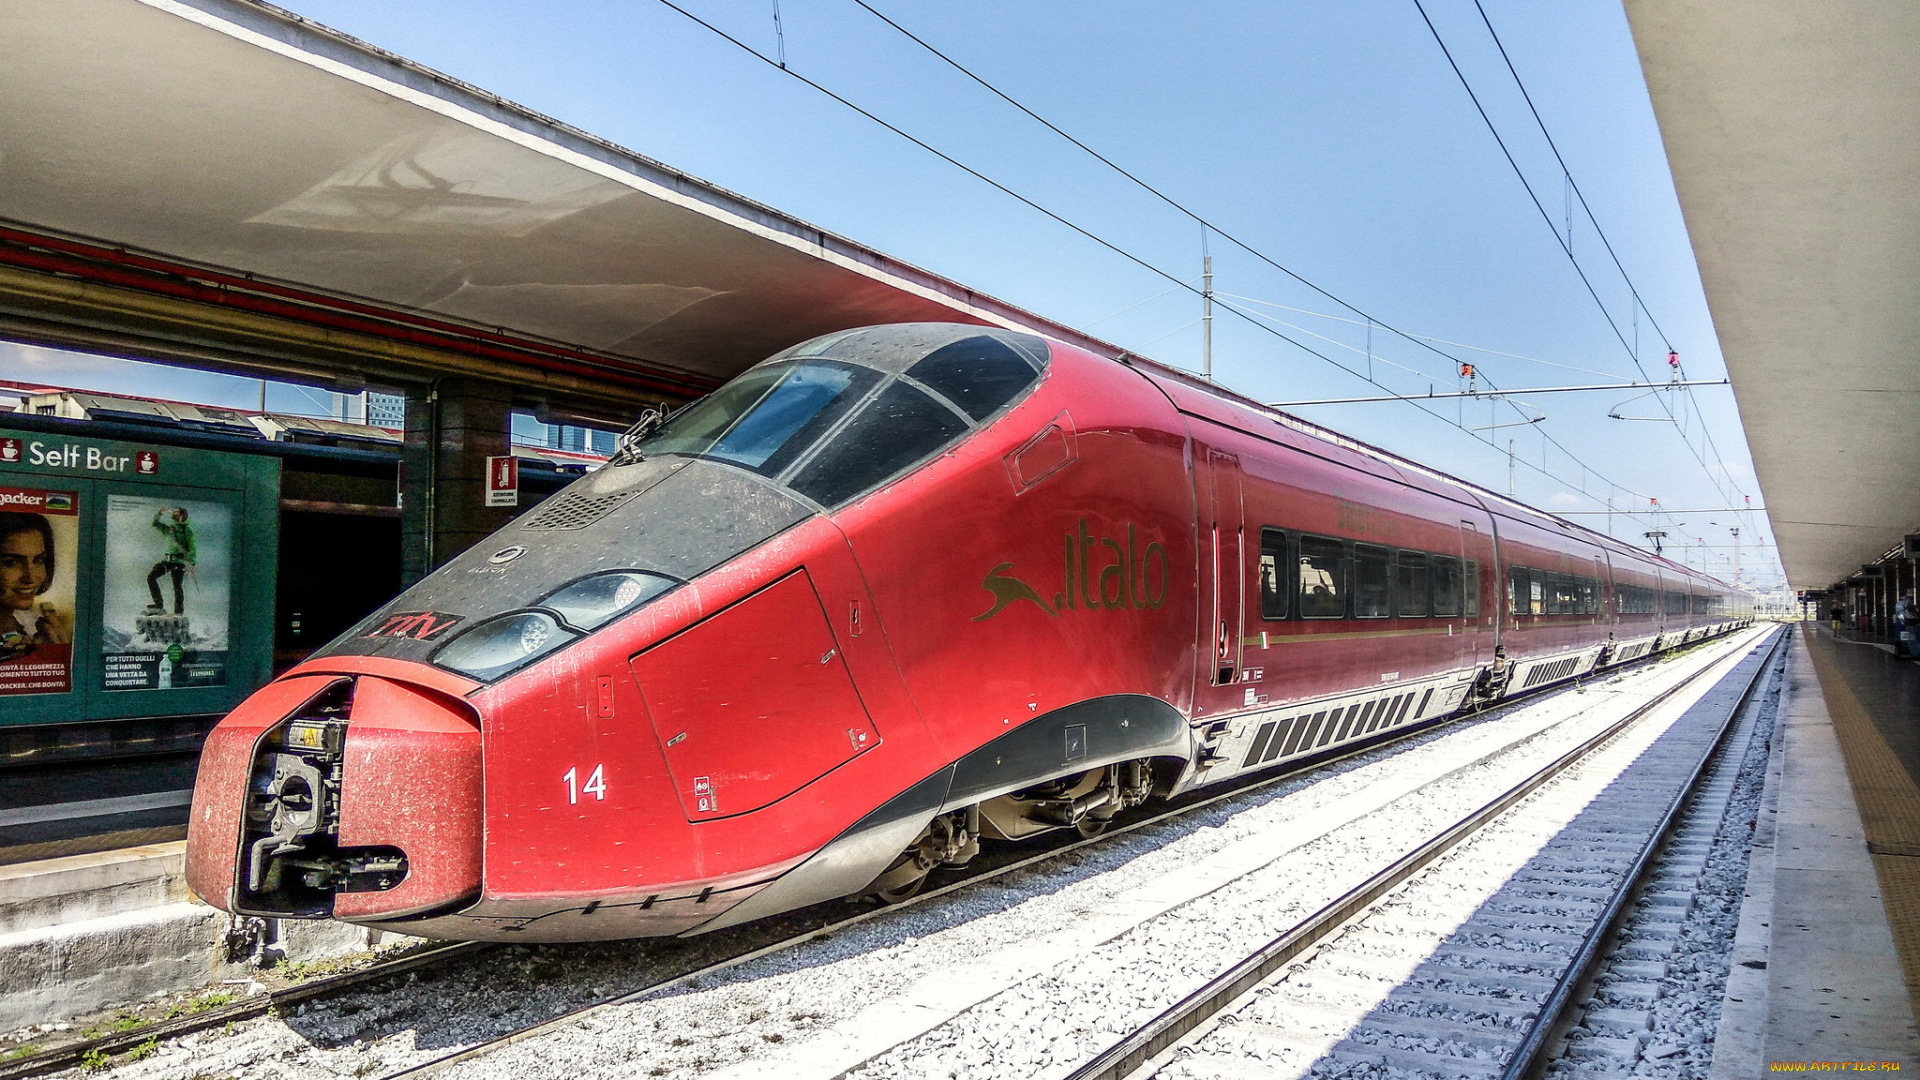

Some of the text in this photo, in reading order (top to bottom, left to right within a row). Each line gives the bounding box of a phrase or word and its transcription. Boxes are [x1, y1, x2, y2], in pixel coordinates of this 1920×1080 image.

[29, 441, 130, 472] Self Bar
[562, 763, 607, 805] 14
